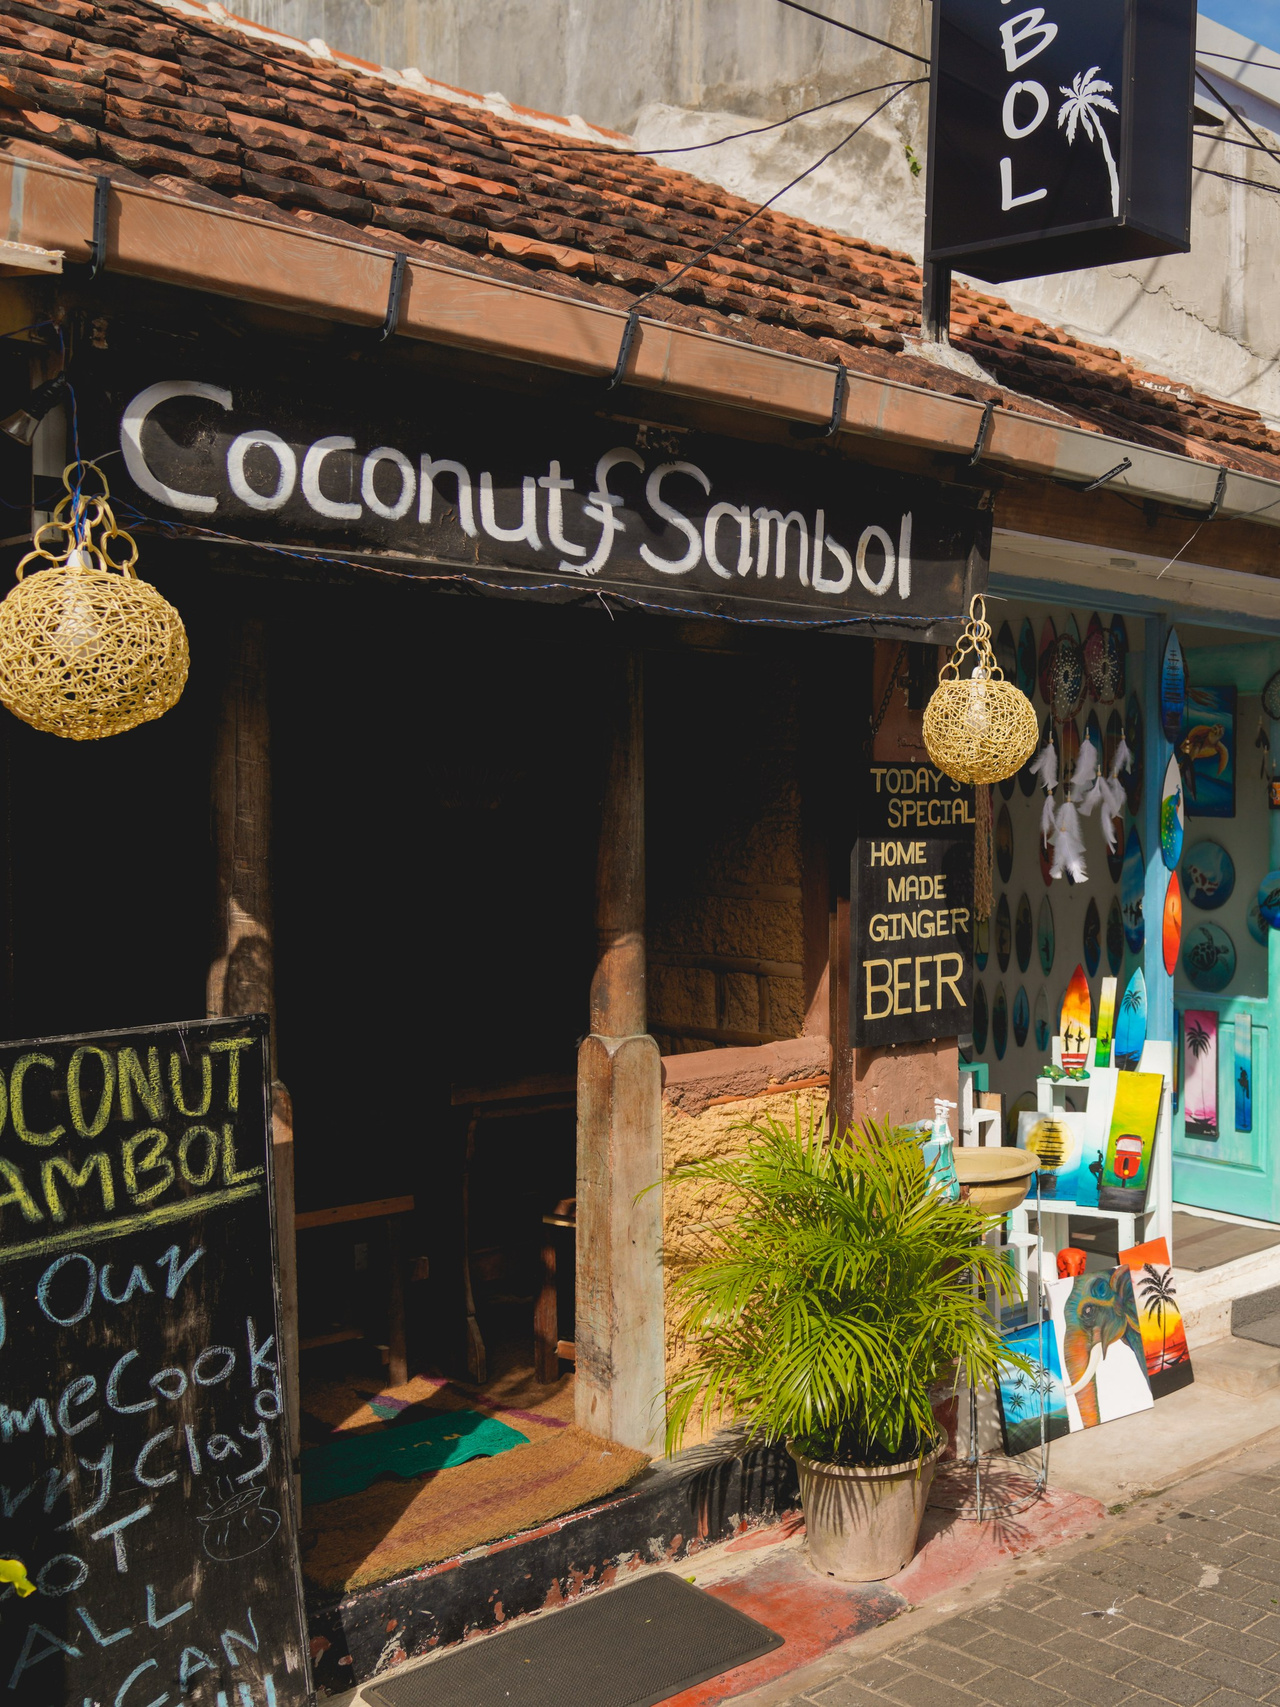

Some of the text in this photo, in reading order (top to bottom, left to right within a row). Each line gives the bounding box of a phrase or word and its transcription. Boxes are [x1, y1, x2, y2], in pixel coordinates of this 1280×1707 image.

[120, 380, 587, 557] Coconut
[640, 460, 913, 601] Sambol
[870, 841, 927, 867] HOME
[887, 798, 976, 829] SPECIAL
[869, 907, 971, 942] GINGER
[887, 875, 947, 903] MADE
[862, 952, 968, 1021] BEER
[0, 1036, 259, 1148] CONUT
[0, 1504, 154, 1600] OT
[8, 1584, 194, 1690] ALL
[114, 1607, 260, 1707] CAN
